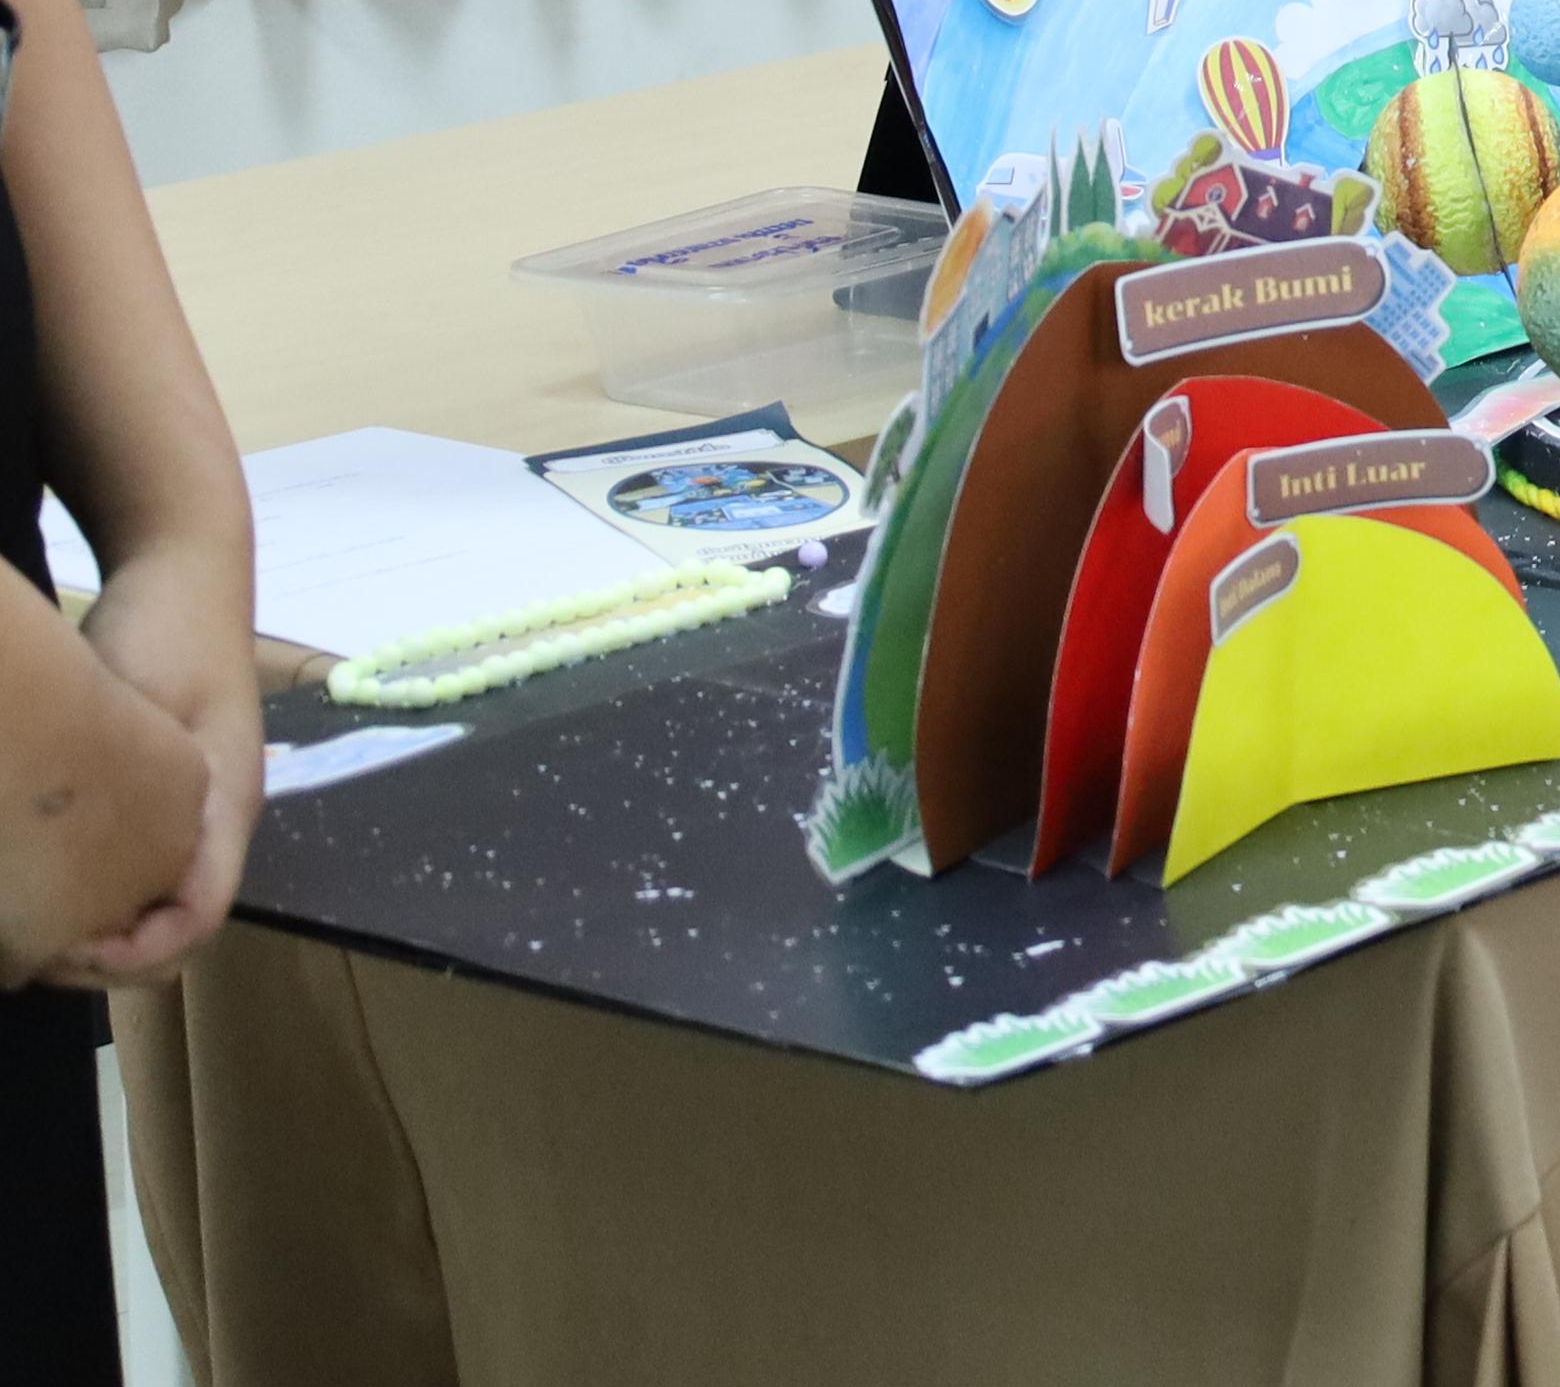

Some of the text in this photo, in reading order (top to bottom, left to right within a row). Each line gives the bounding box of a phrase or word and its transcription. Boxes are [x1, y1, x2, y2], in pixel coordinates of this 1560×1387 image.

[1144, 266, 1353, 327] kerak Bumi
[1280, 461, 1426, 500] Inti Luar
